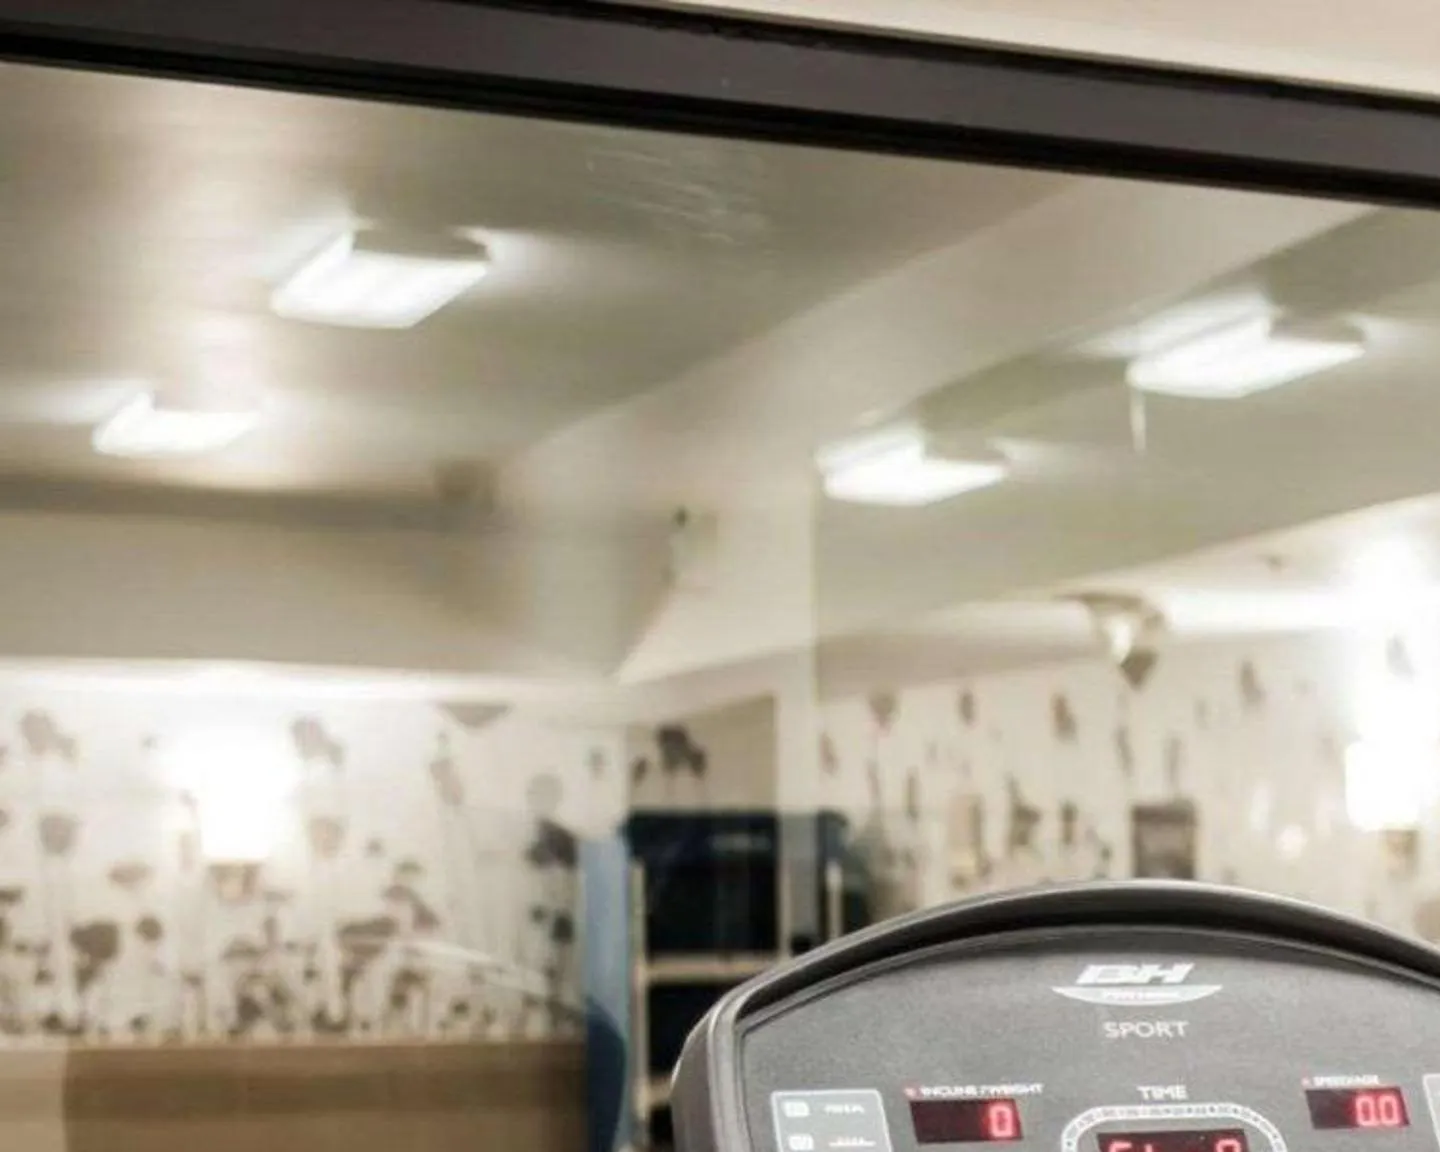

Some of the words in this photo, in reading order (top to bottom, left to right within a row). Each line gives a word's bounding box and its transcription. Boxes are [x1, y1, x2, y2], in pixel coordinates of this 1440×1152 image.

[1076, 962, 1195, 984] BH
[1103, 1021, 1189, 1039] SPORT
[1137, 1083, 1189, 1100] TIME
[988, 1105, 1014, 1139] 0
